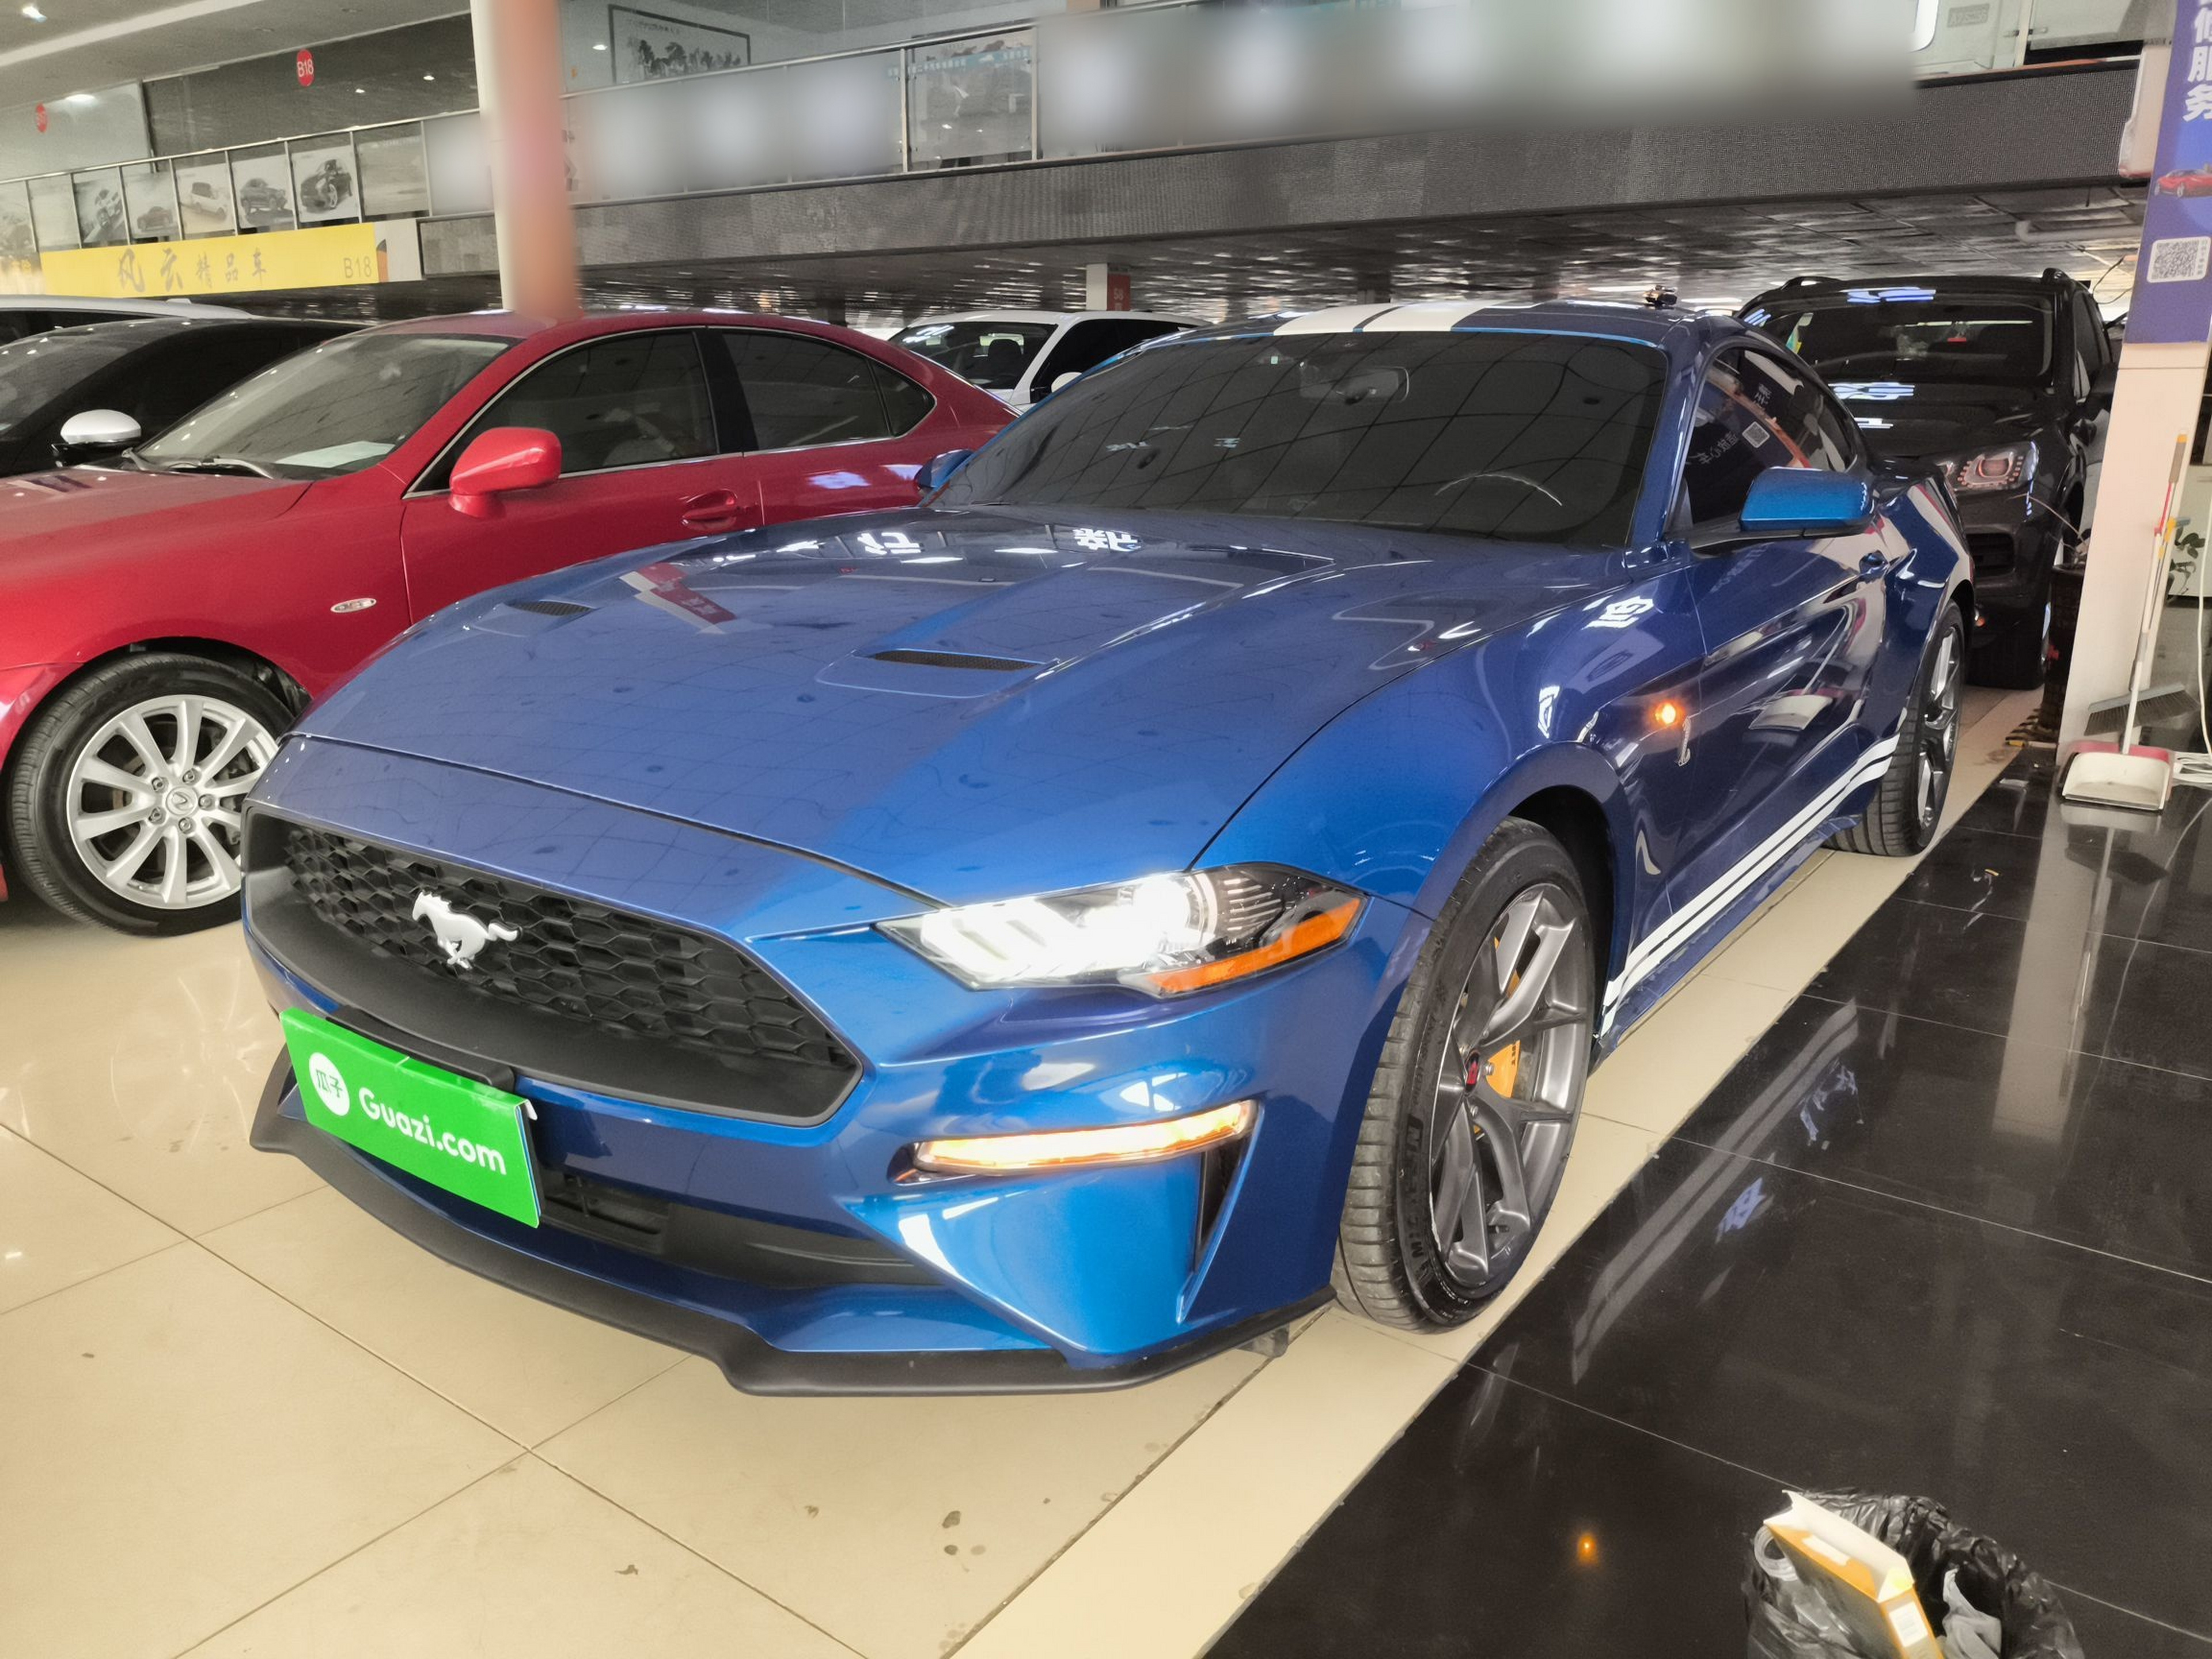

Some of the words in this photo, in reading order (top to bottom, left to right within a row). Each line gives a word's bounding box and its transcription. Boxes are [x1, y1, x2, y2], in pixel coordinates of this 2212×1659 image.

[297, 58, 314, 77] B18
[343, 256, 373, 279] B18
[315, 1070, 343, 1099] 瓜子
[358, 1087, 507, 1175] Guazi.com
